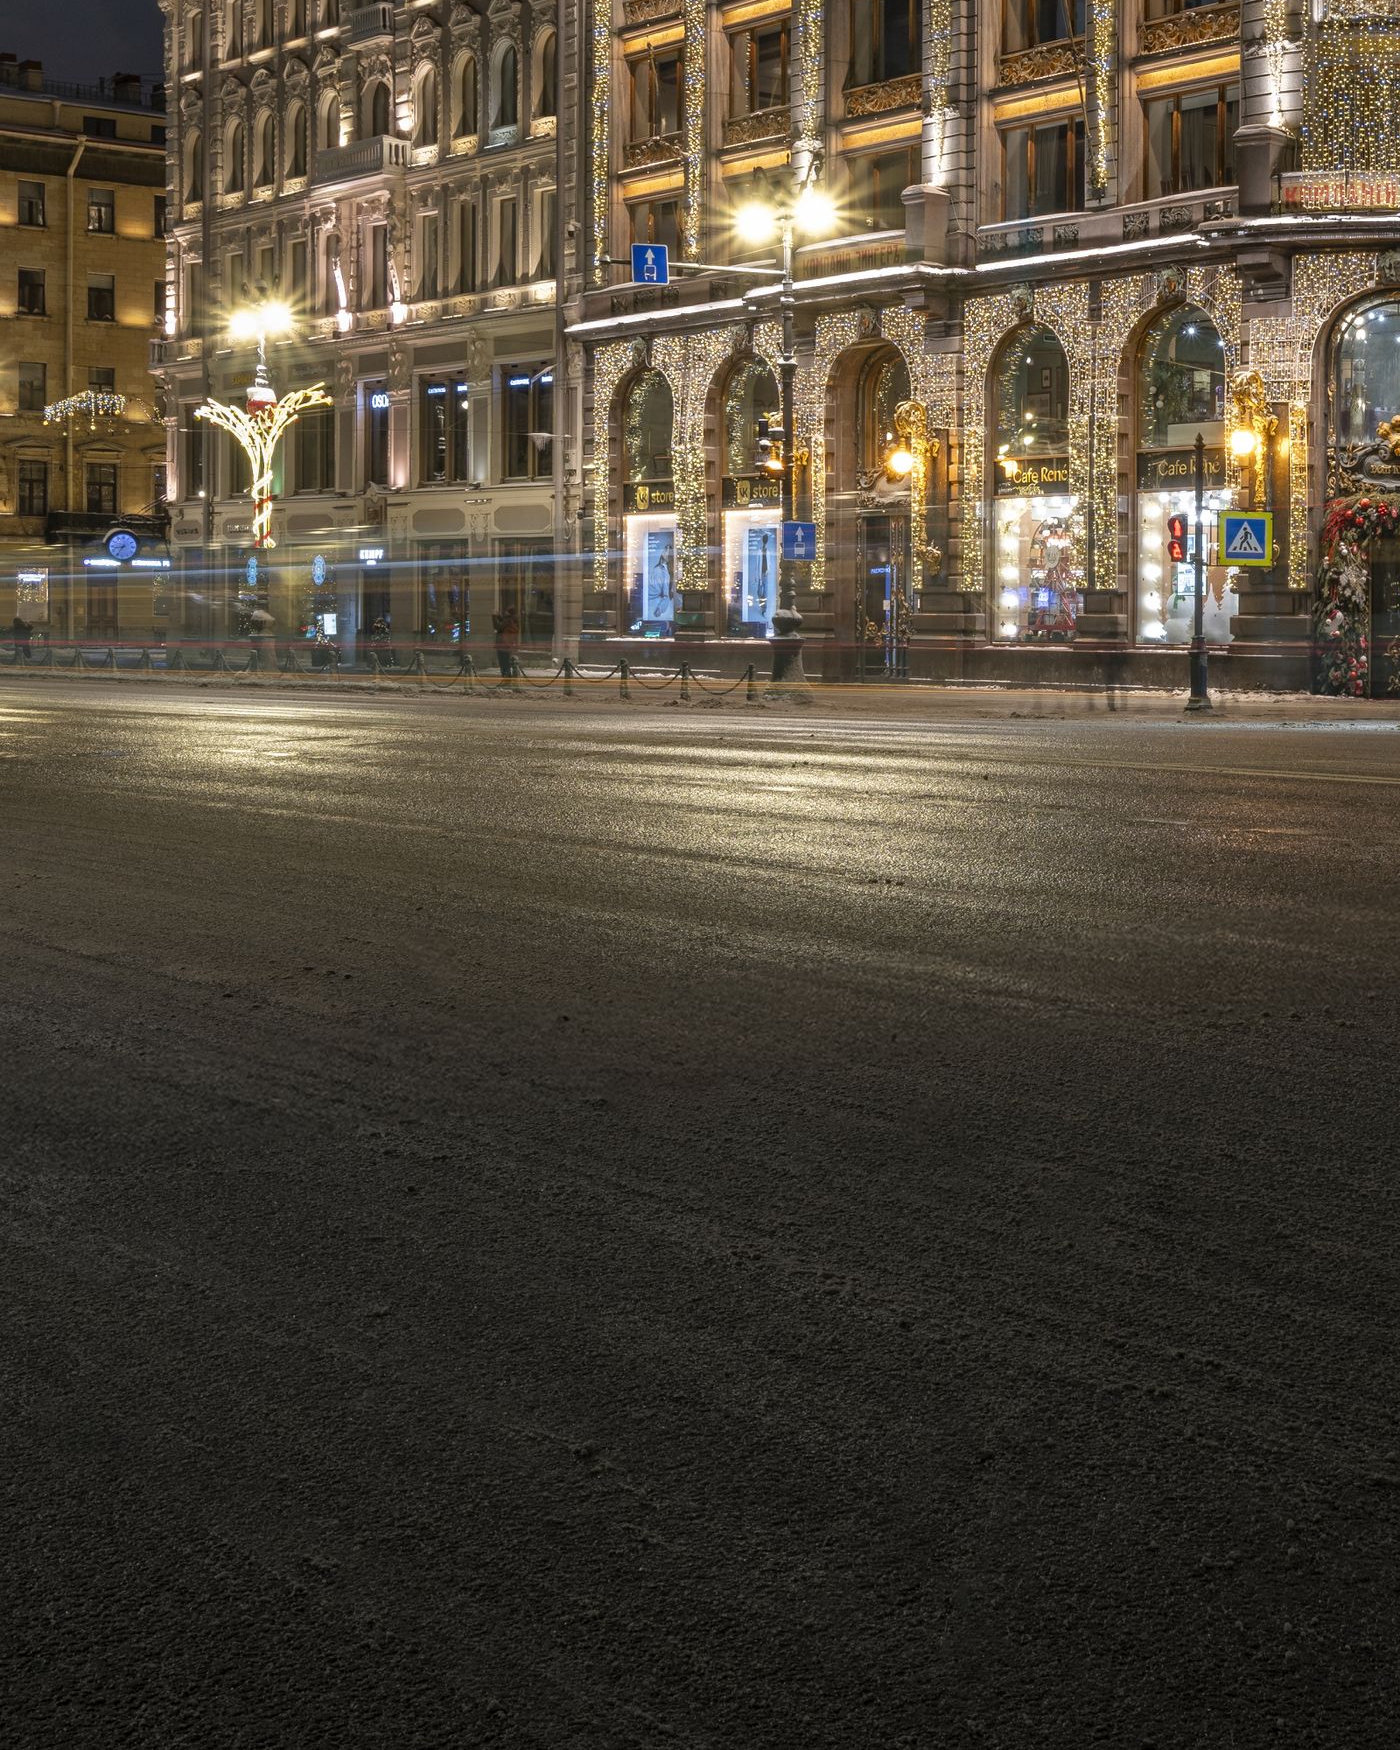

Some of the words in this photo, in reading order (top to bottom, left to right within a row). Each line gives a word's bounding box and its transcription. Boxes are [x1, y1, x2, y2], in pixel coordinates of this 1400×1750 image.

[1013, 467, 1039, 484] Cafe
[1041, 463, 1068, 482] René
[1159, 458, 1187, 476] Cafe
[651, 491, 674, 504] store
[753, 485, 778, 498] store
